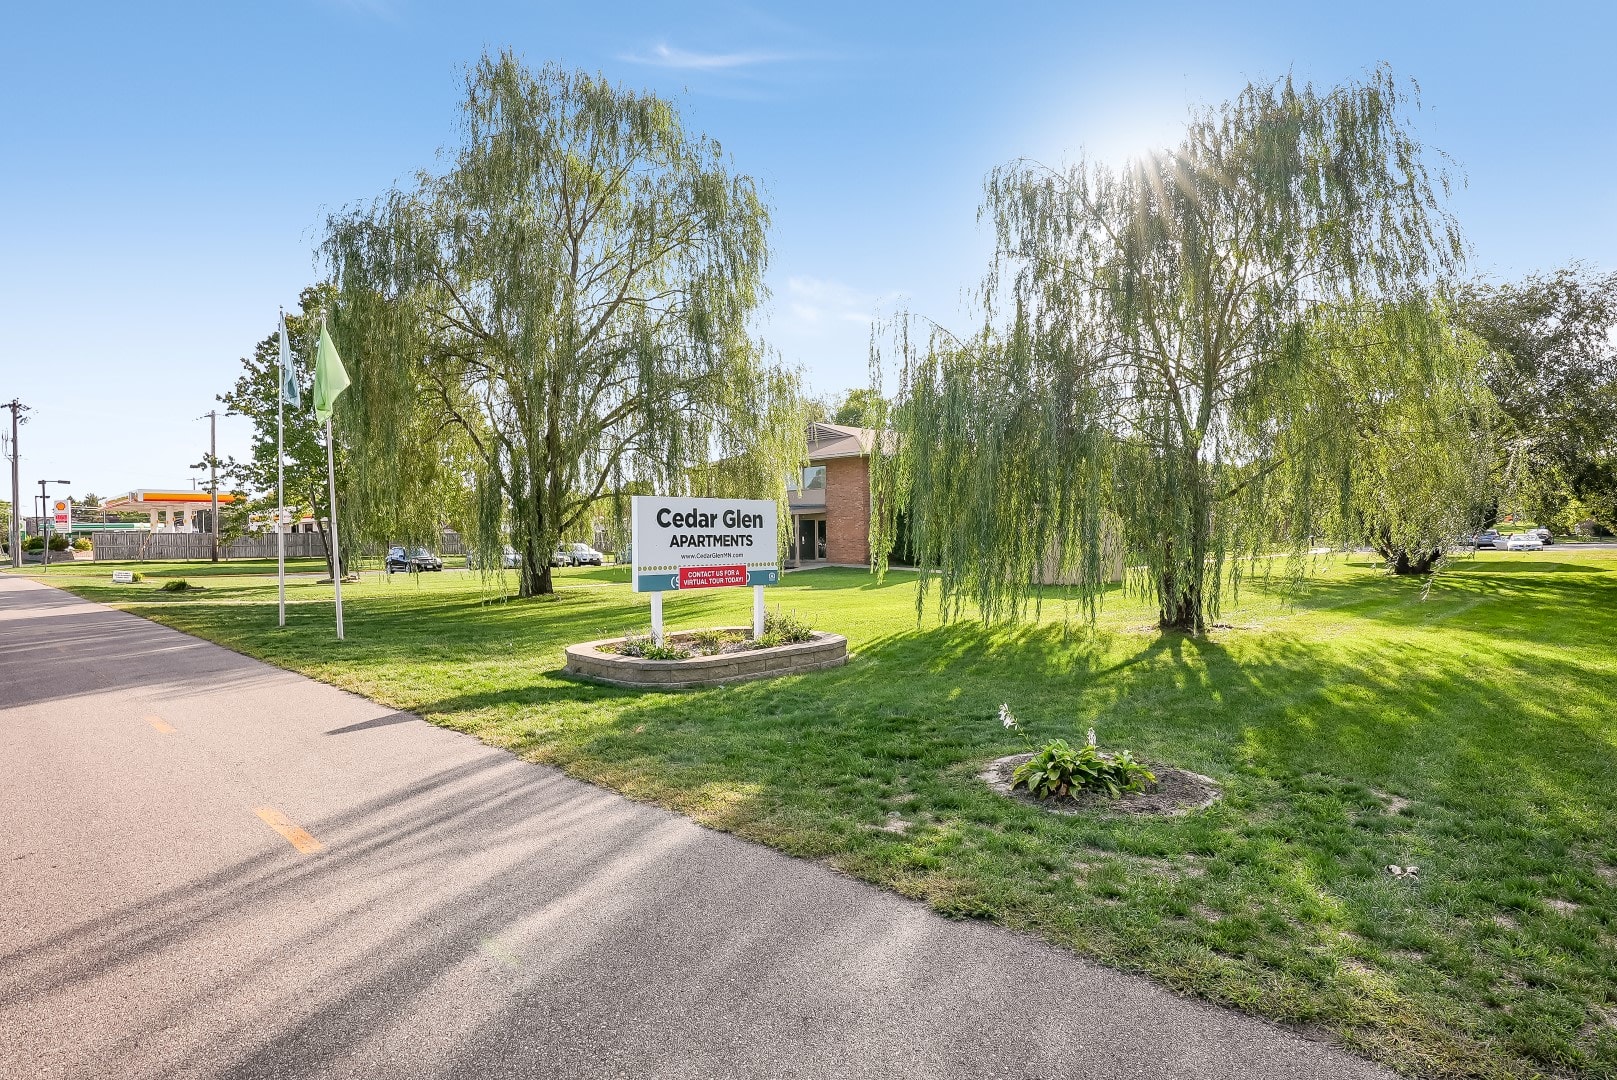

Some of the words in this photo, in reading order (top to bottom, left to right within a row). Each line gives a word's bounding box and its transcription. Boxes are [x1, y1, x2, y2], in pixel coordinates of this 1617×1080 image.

[657, 508, 717, 528] Cedar
[723, 509, 763, 528] Glen
[670, 535, 753, 547] APARTMENTS
